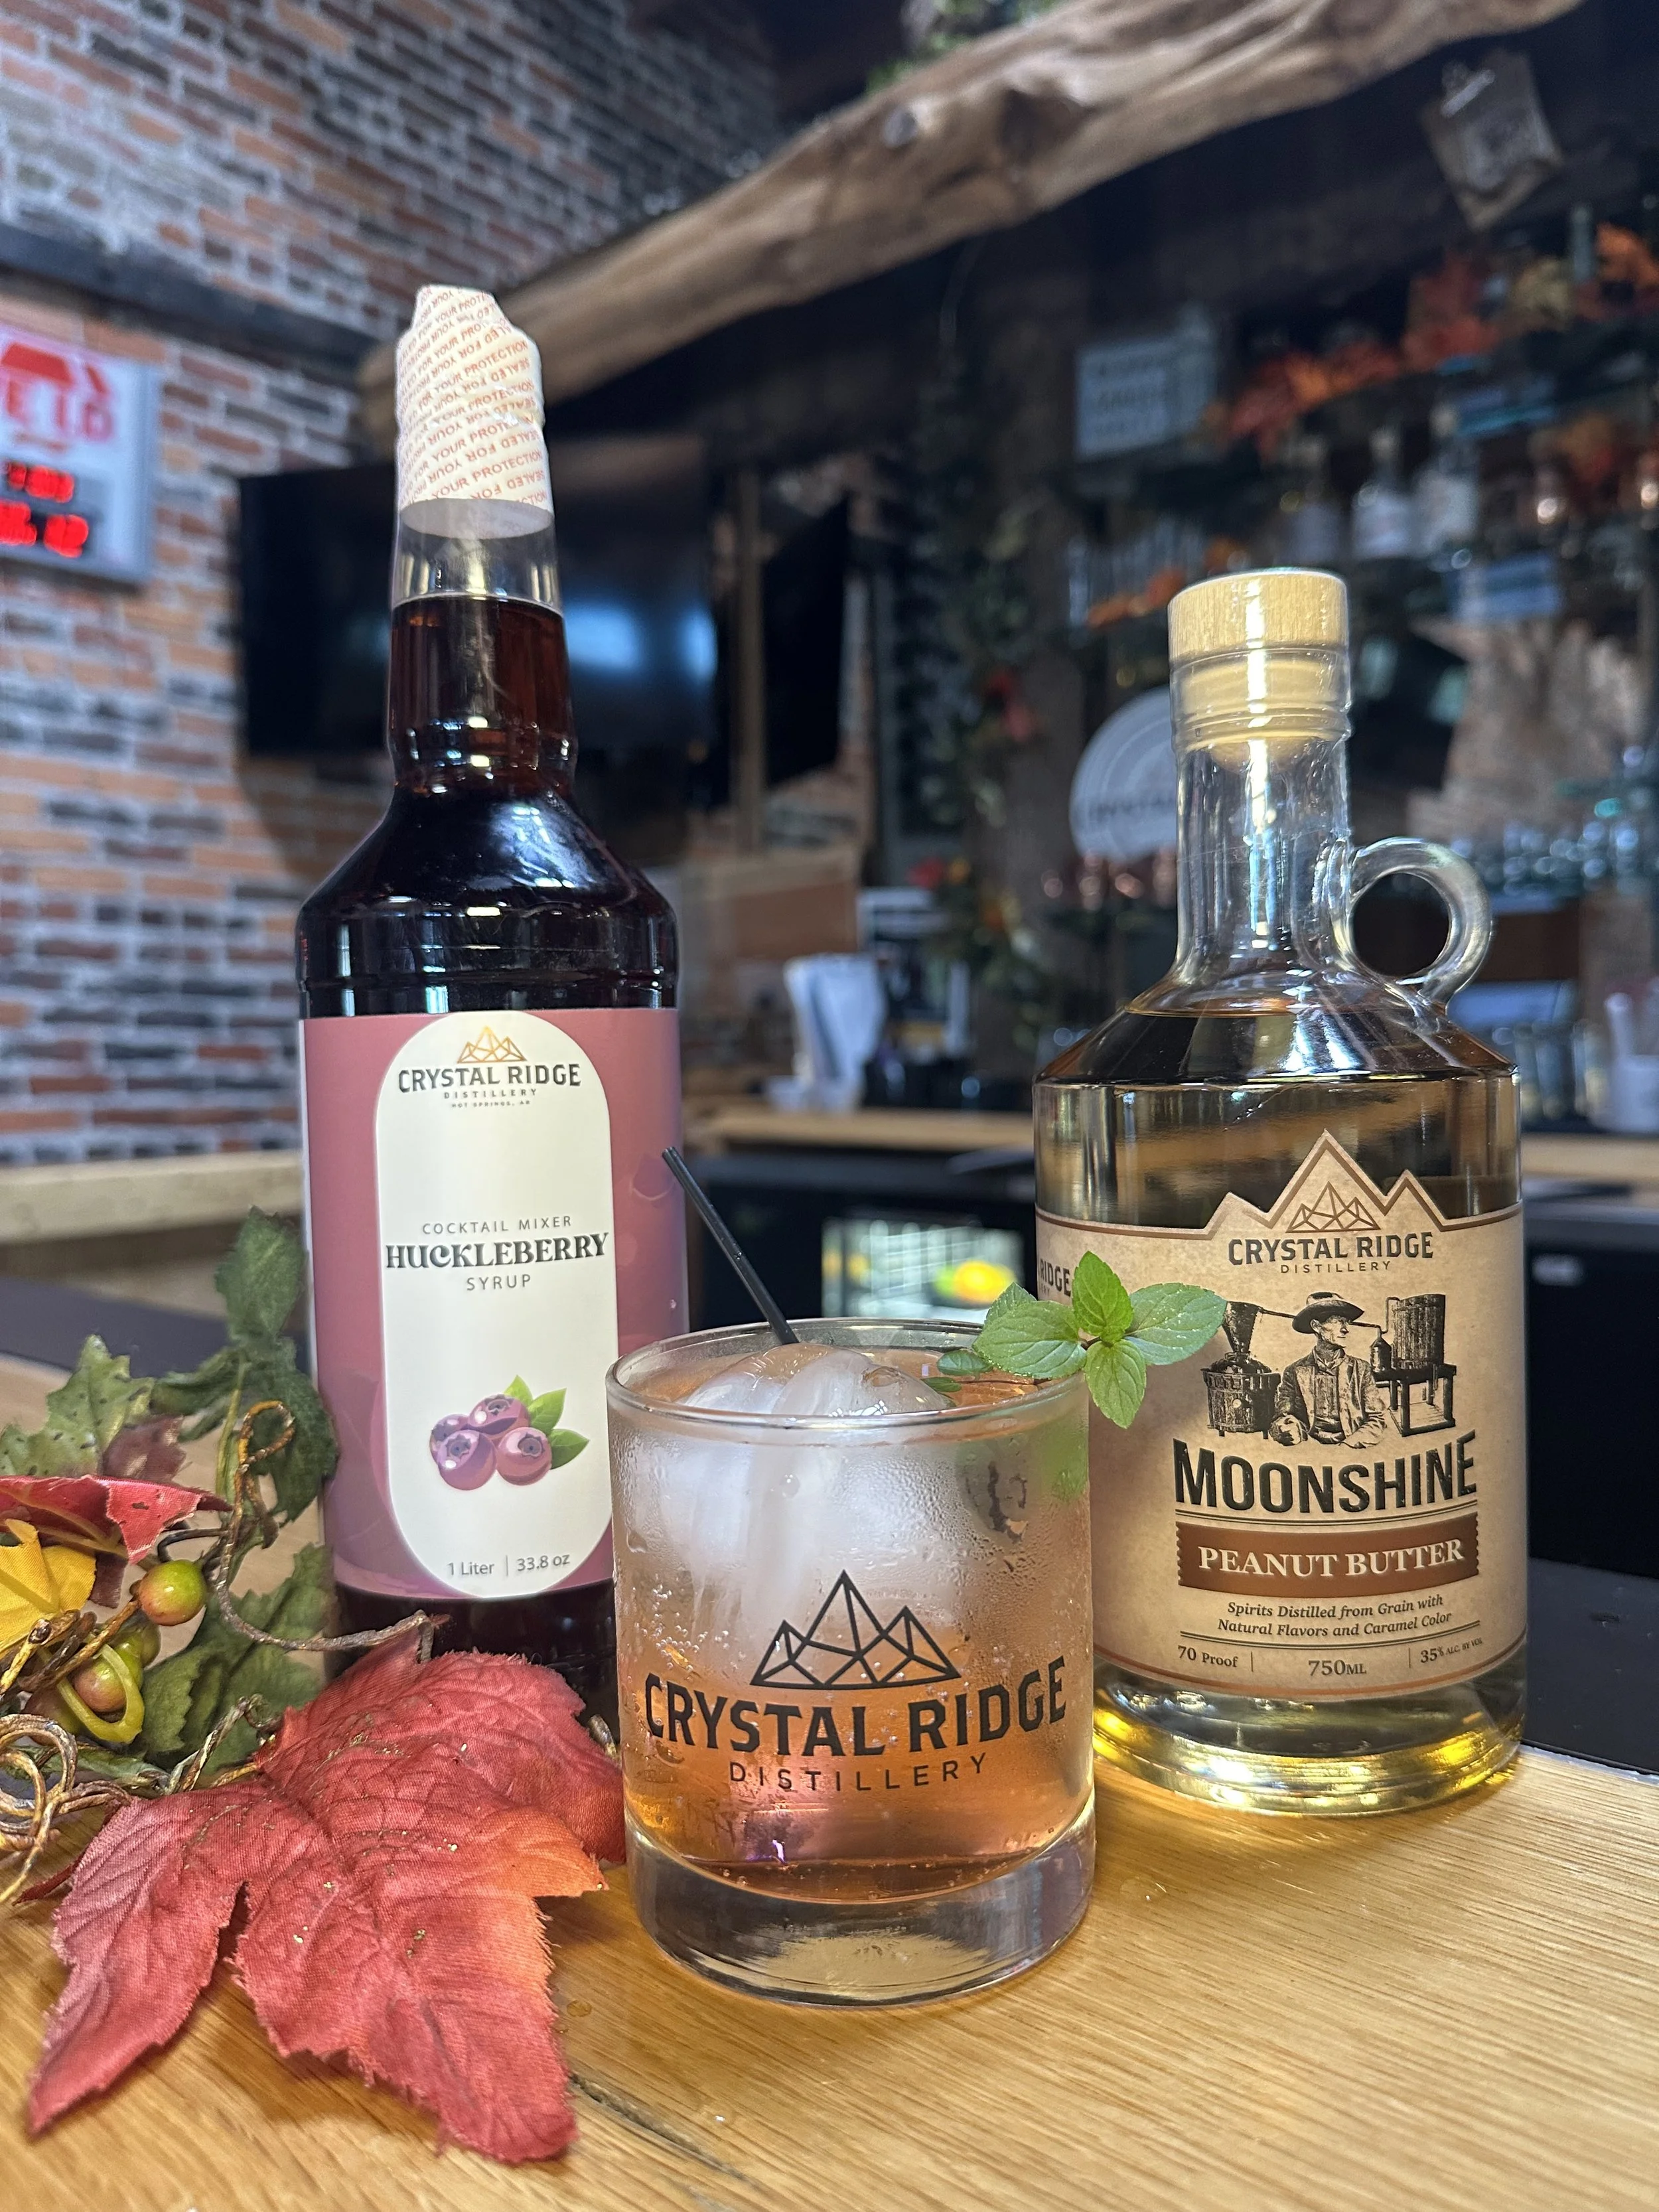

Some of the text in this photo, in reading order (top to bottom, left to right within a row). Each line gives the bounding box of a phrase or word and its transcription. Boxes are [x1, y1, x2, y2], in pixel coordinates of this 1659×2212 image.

[434, 337, 459, 358] YOUR
[465, 339, 528, 377] PROTECTION
[428, 422, 463, 445] YOUR
[431, 439, 467, 462] YOUR
[465, 443, 496, 462] FOR
[427, 459, 462, 483] YOUR
[472, 449, 543, 482] PROTECTION
[399, 1063, 581, 1093] CRYSTAL RIDGE
[444, 1088, 538, 1100] DISTILLERY
[422, 1215, 572, 1234] COCKTAIL MIXER
[386, 1232, 609, 1268] HUCKLEBERRY
[1228, 1231, 1433, 1266] CRYSTAL RIDGE
[1040, 1258, 1072, 1297] RIDGE
[1281, 1260, 1391, 1274] DISTILLERY
[467, 1274, 532, 1291] SYRUP
[1173, 1429, 1477, 1513] MOONSHINE
[447, 1561, 495, 1576] 1 Liter
[517, 1554, 571, 1572] 33.8 oz
[1197, 1538, 1465, 1578] PEANUT BUTTER
[1227, 1593, 1444, 1620] Spirits Distilled from Grain with
[1217, 1611, 1453, 1637] Natural Flavors and Caramel Color
[1178, 1645, 1239, 1668] 70 Proof
[1420, 1646, 1445, 1663] 35%
[1308, 1659, 1367, 1676] 750ML
[644, 1655, 1067, 1757] CRYSTAL RIDGE
[729, 1751, 987, 1791] DISTILLERY
